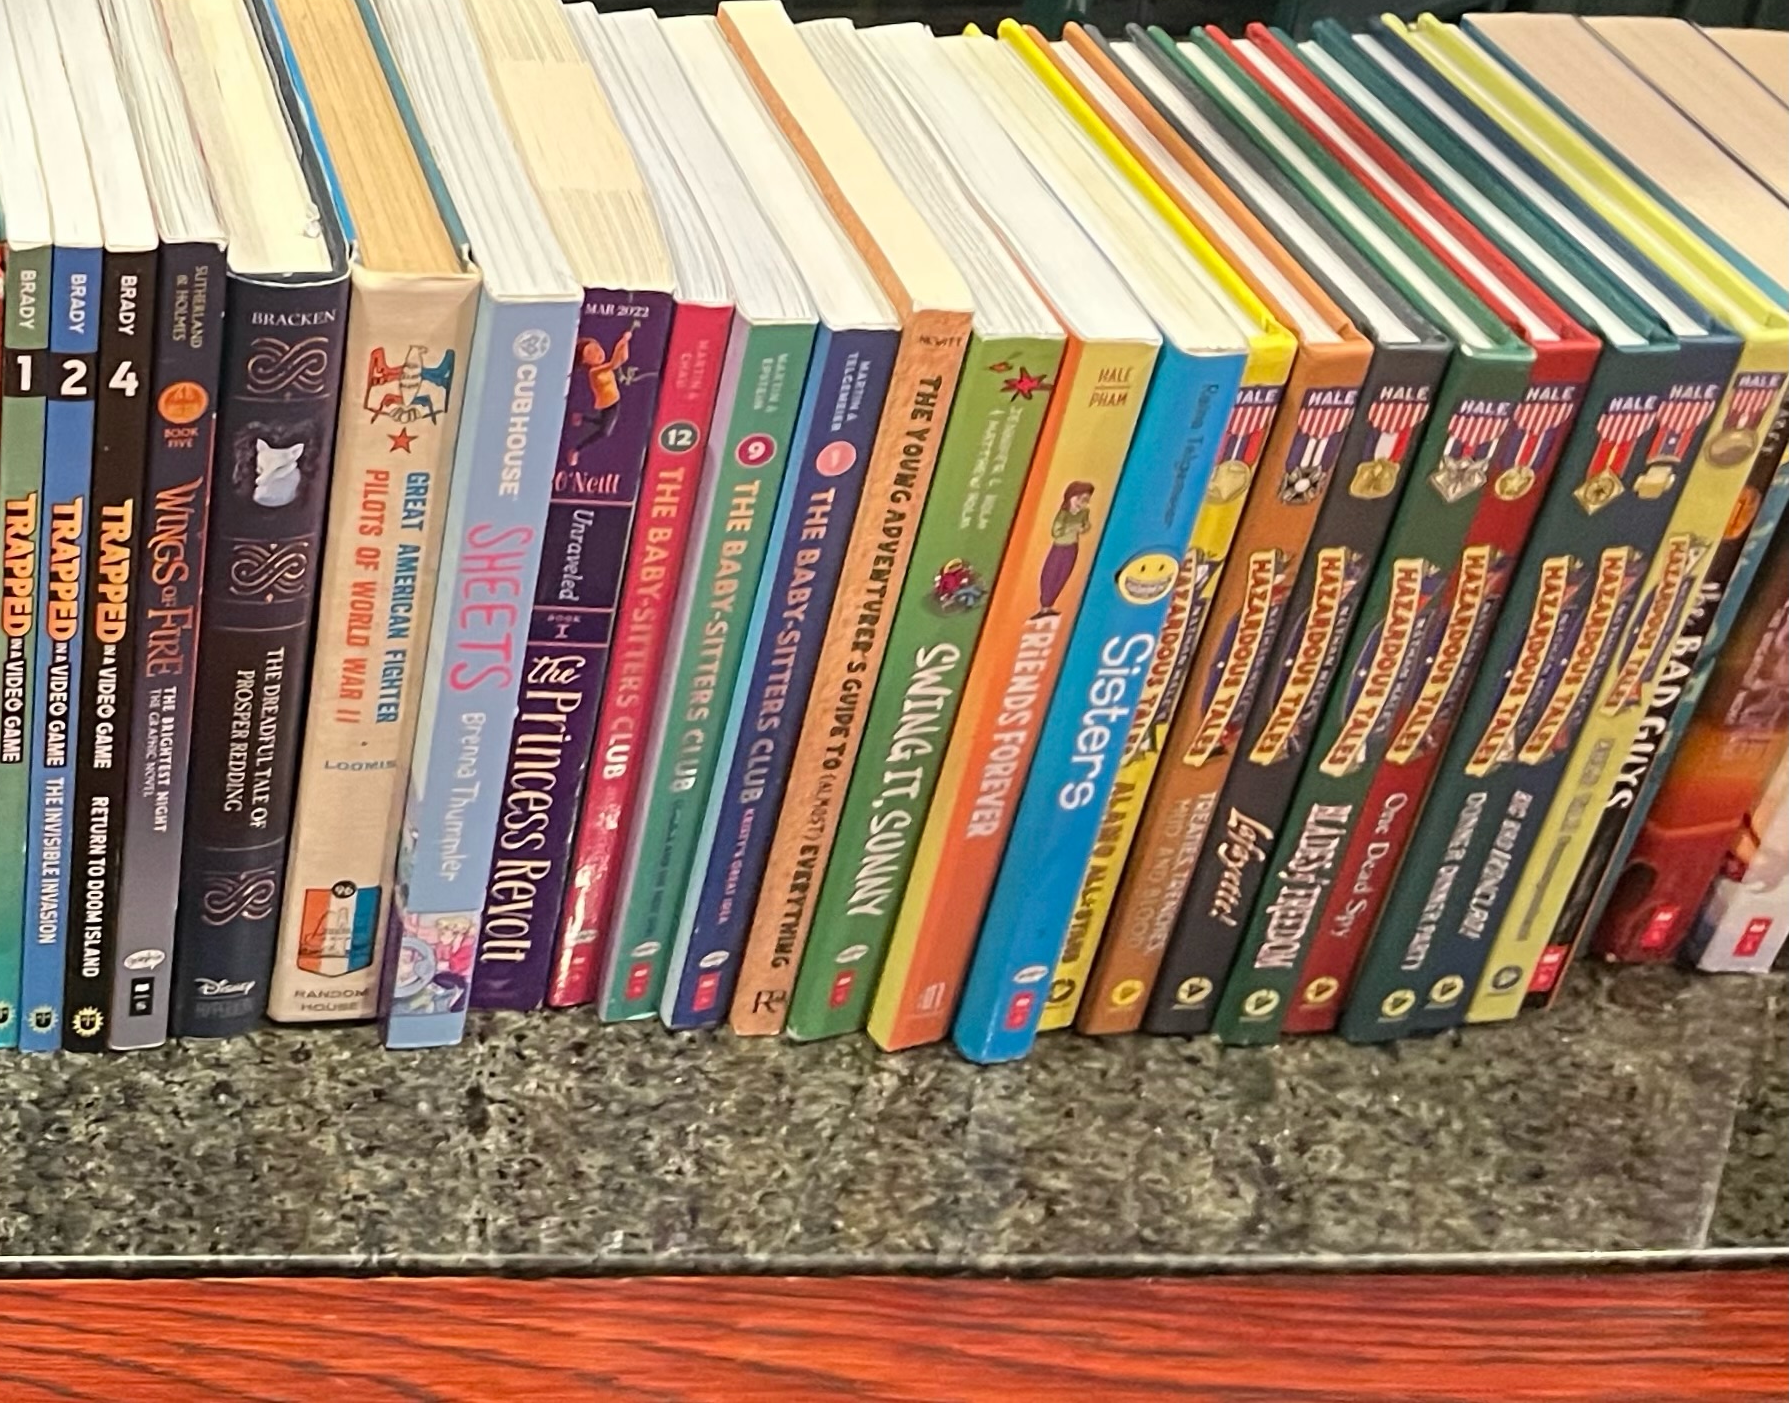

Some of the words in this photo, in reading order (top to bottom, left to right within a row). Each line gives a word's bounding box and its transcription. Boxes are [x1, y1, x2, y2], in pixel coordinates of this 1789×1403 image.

[19, 269, 37, 330] BRADY
[68, 273, 87, 335] BRADY
[118, 275, 138, 336] BRADY
[190, 265, 209, 349] SUTHERLAND
[252, 309, 336, 326] BRACKEN
[585, 303, 615, 315] MAR
[17, 355, 32, 391] 1
[61, 359, 87, 395] 2
[109, 361, 139, 397] 4
[1088, 393, 1127, 408] PHAM
[1098, 367, 1134, 383] HALE
[1309, 390, 1358, 405] HALE
[1380, 386, 1430, 401] HALE
[1525, 386, 1575, 401] HALE
[499, 363, 537, 496] CUBHOUSE
[1460, 400, 1511, 415] HALE
[555, 470, 620, 494] O'Neill
[890, 428, 931, 504] YOUNG
[147, 476, 203, 586] WINGS
[359, 469, 390, 537] PILOTS
[400, 472, 430, 531] GREAT
[3, 490, 37, 637] TRAPPED
[47, 497, 83, 642] TRAPPED
[95, 498, 134, 643] TRAPPED
[559, 508, 594, 601] Unraveled
[346, 580, 377, 647] WORLD
[387, 544, 421, 639] AMERICAN
[449, 523, 534, 691] SHEETS
[616, 527, 673, 708] BABY-SITTERS
[846, 509, 907, 674] ADVENTURER'S
[145, 605, 194, 678] FIRE
[686, 540, 748, 722] BABY-SITTERS
[757, 548, 822, 732] BABY-SITTERS
[1223, 559, 1272, 688] HAZARDOUS
[4, 661, 24, 712] VIDEO
[49, 664, 69, 716] VIDEO
[96, 667, 117, 719] VIDEO
[340, 657, 369, 702] WAR
[376, 649, 407, 724] FIGHTER
[885, 642, 961, 763] SWING
[1653, 635, 1703, 707] BAD
[231, 669, 255, 739] PROSPER
[256, 684, 280, 766] DREADFUL
[334, 708, 361, 724] II
[829, 678, 862, 739] GUIDE
[1059, 633, 1155, 810] Sisters
[2, 716, 22, 762] GAME
[46, 720, 66, 767] GAME
[93, 722, 114, 769] GAME
[158, 716, 175, 786] BRIGHTEST
[325, 760, 397, 771] LOOMIS
[457, 712, 486, 779] Brenna
[501, 690, 583, 851] Princess
[603, 715, 635, 780] CLUB
[670, 728, 706, 793] CLUB
[822, 742, 848, 771] TO
[1604, 716, 1666, 809] GUYS
[224, 743, 248, 812] REDDING
[253, 768, 273, 805] TALE
[739, 737, 775, 805] CLUB
[871, 766, 924, 809] IT,
[966, 729, 1028, 840] FOREVER
[42, 808, 63, 877] INVISIBLE
[88, 797, 110, 855] RETURN
[153, 790, 170, 832] NIGHT
[439, 780, 480, 882] Thummler
[1375, 793, 1408, 834] One
[87, 858, 105, 877] TO
[847, 808, 913, 917] SUNNY
[1353, 842, 1391, 894] Dead
[38, 878, 60, 944] INVASION
[85, 879, 105, 924] DOOM
[479, 859, 551, 964] Revolt
[771, 844, 819, 969] EVERYTHING
[1330, 899, 1368, 938] Spy
[82, 926, 102, 978] ISLAND
[294, 987, 369, 998] RANDOM
[301, 1001, 360, 1012] HOUSE
